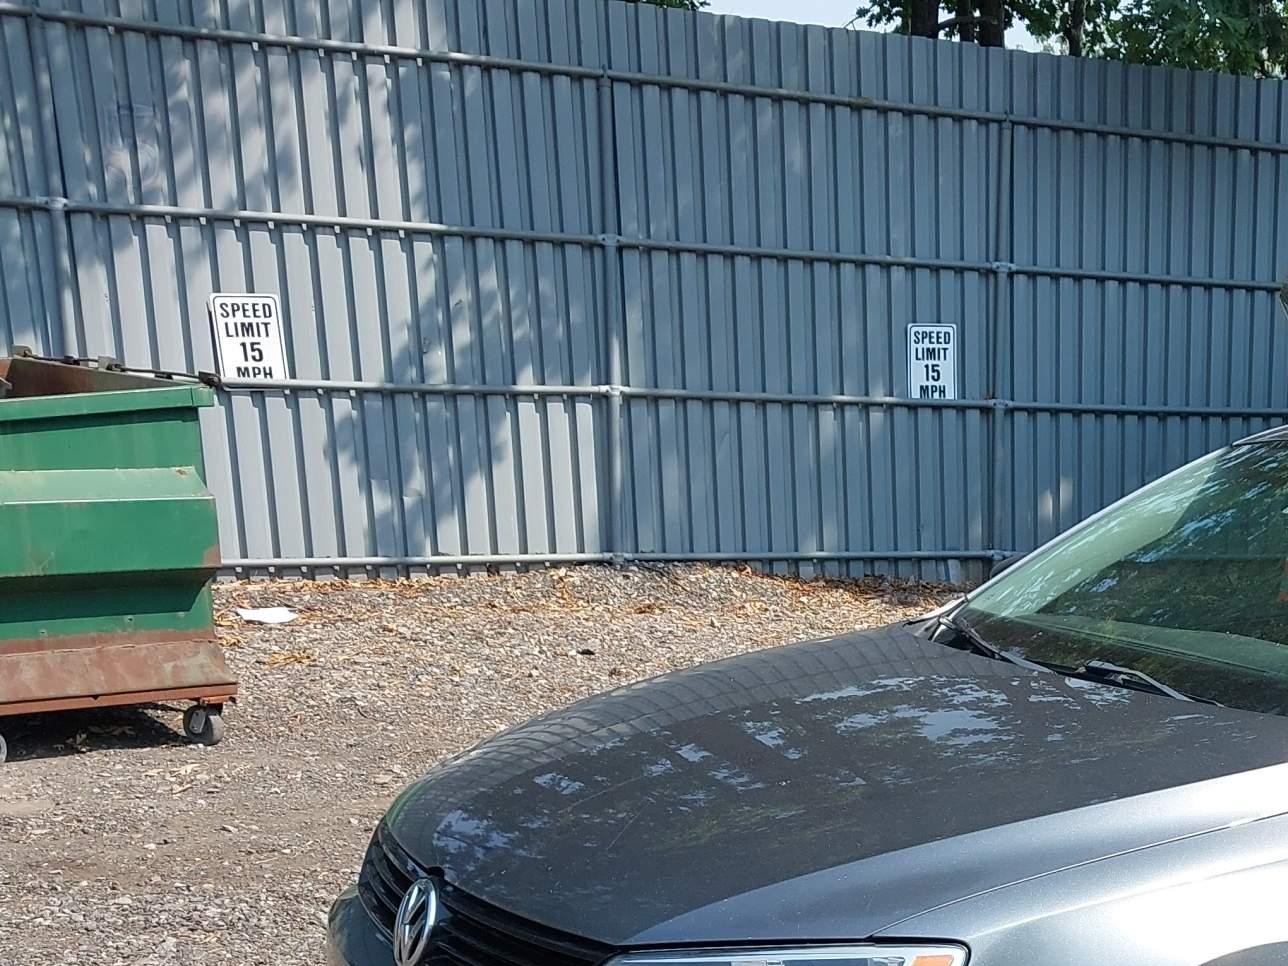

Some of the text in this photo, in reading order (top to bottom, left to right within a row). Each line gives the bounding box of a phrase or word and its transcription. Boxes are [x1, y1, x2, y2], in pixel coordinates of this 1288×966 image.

[219, 302, 273, 319] SPEED
[224, 321, 272, 338] LIMIT
[913, 330, 951, 345] SPEED
[239, 341, 264, 363] 15
[915, 347, 949, 362] LIMIT
[236, 366, 274, 380] MPH
[923, 363, 941, 382] 15
[919, 384, 947, 399] MPH
